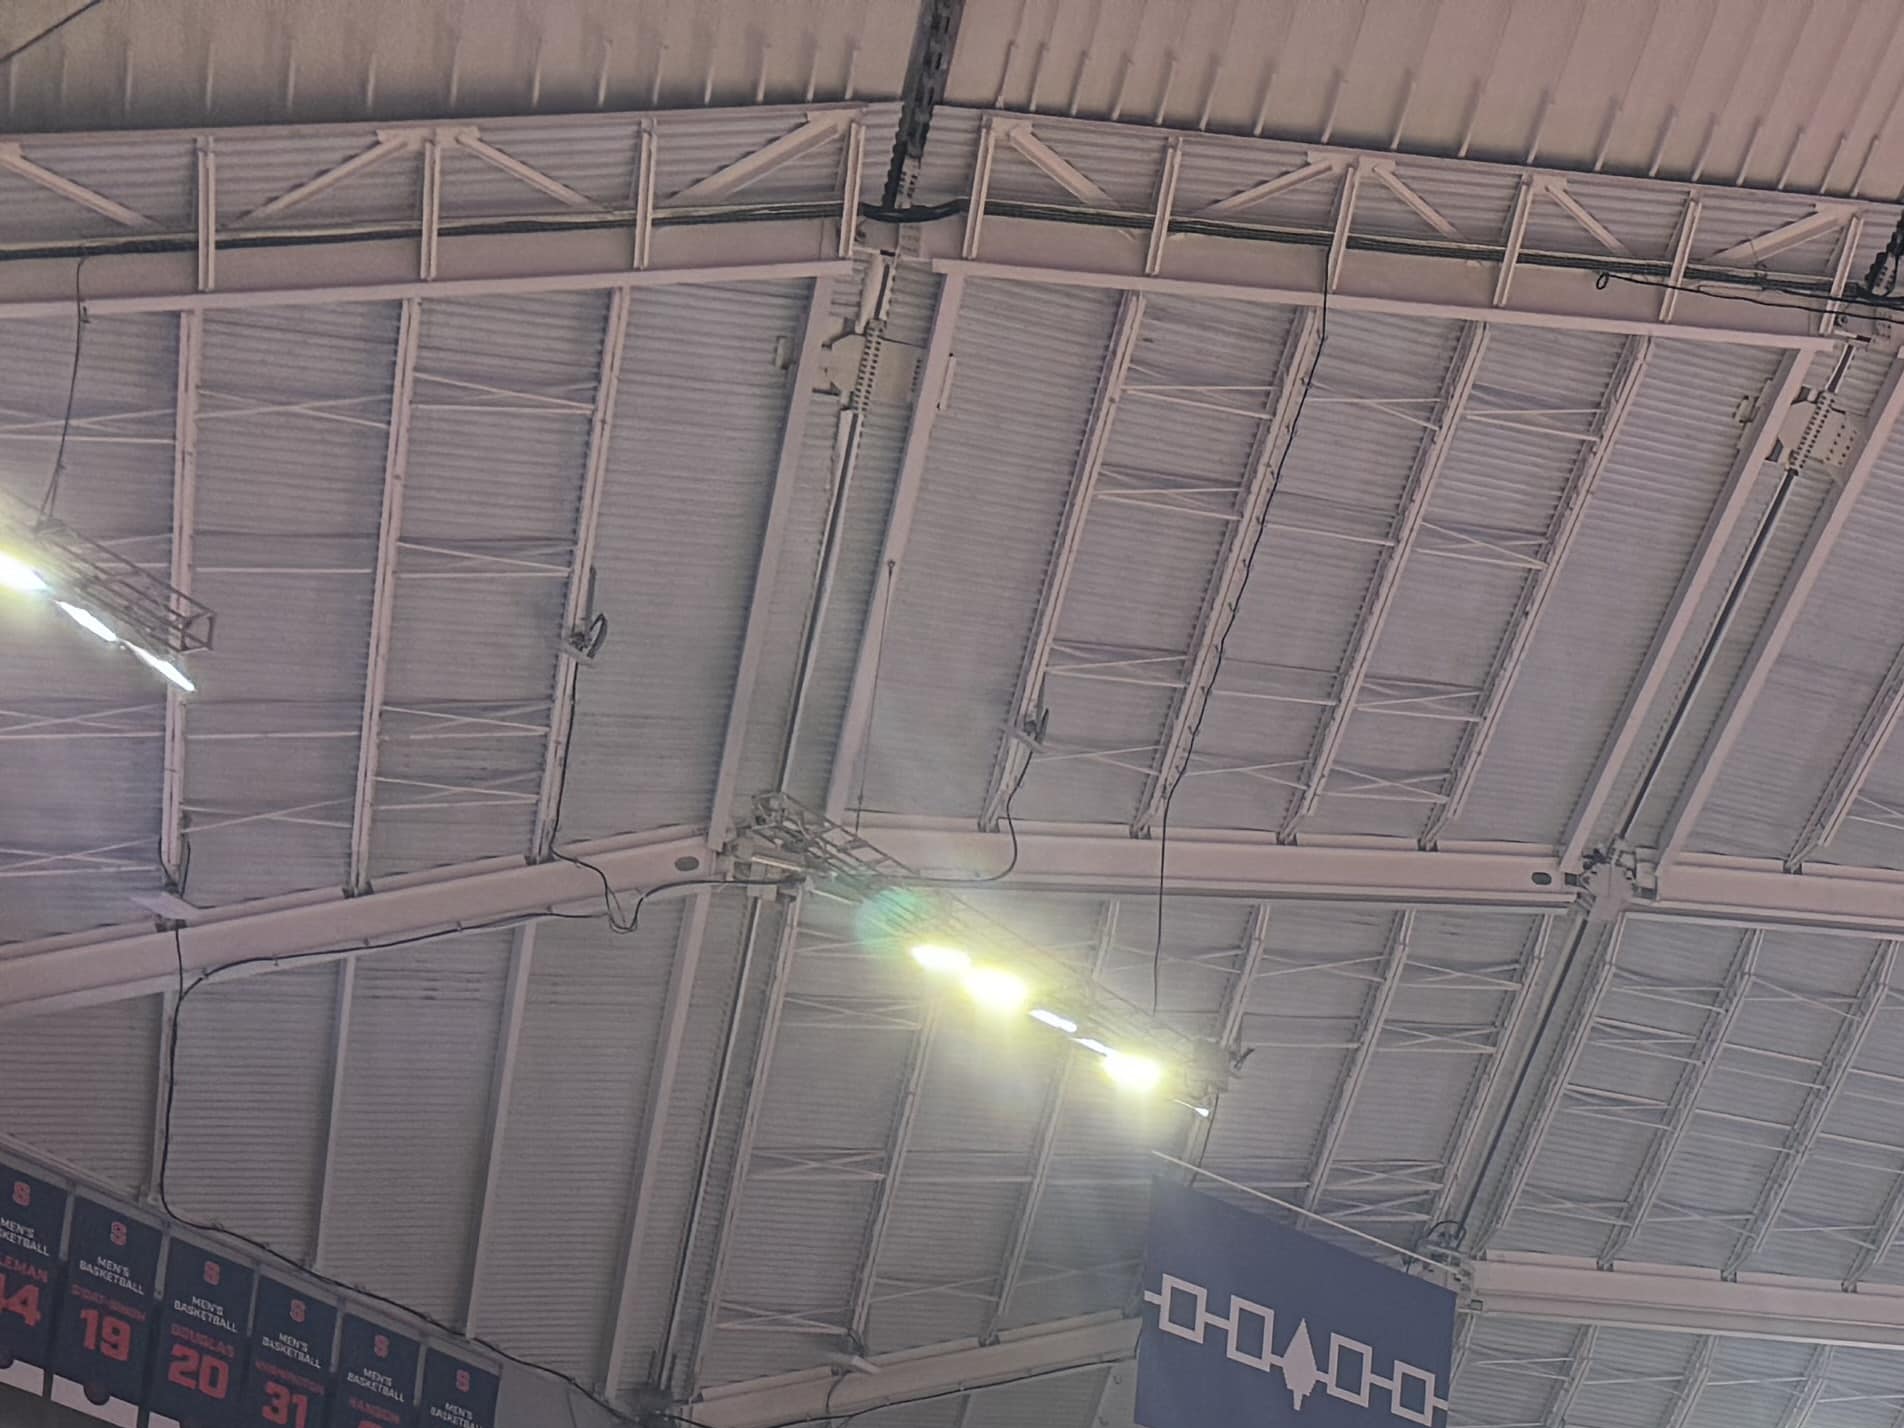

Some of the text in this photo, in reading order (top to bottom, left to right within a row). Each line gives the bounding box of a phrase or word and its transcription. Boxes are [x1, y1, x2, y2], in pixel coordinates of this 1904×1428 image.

[79, 1260, 145, 1296] BASKETBALL
[80, 1309, 132, 1362] 19
[167, 1343, 230, 1399] 20
